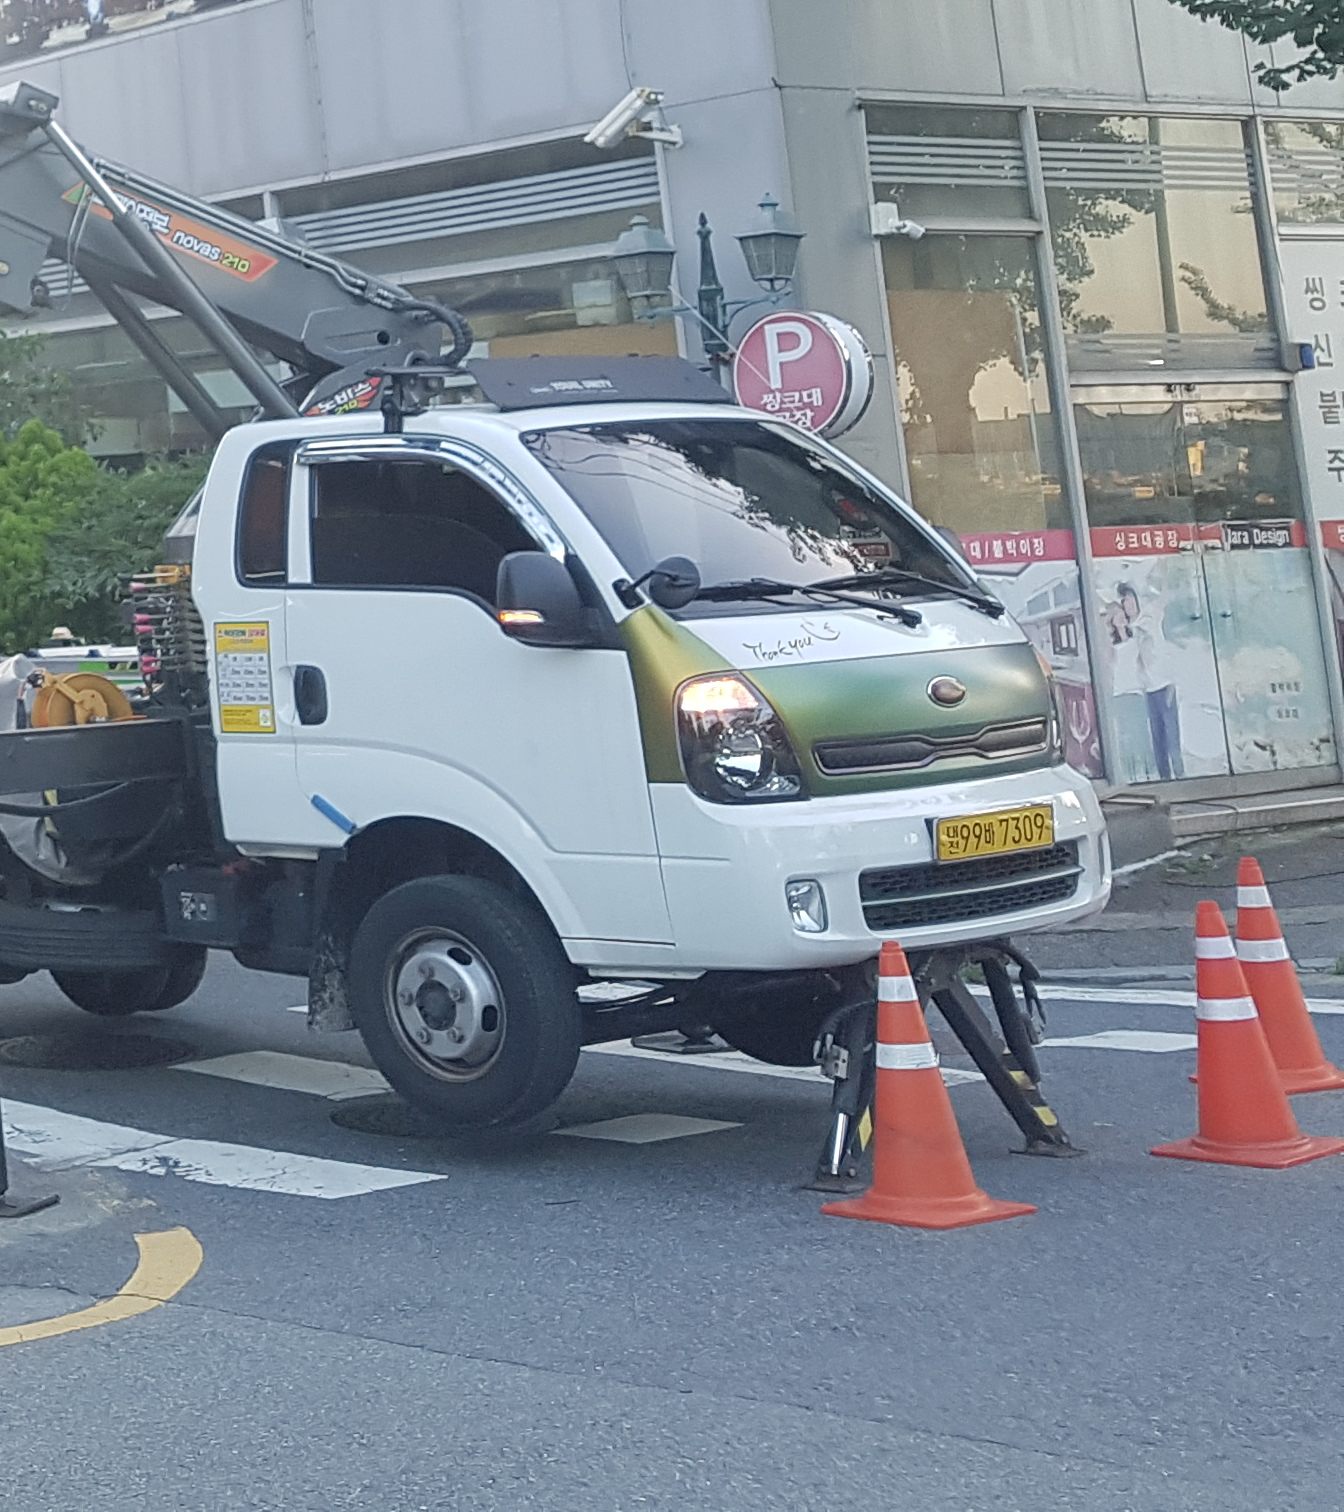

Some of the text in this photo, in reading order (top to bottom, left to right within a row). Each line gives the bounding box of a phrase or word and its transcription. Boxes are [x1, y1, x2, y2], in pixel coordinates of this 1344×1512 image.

[172, 230, 252, 275] novas 210
[764, 321, 812, 390] P
[761, 388, 822, 411] 씽크대
[1253, 528, 1290, 547] Design
[999, 812, 1045, 847] 7309
